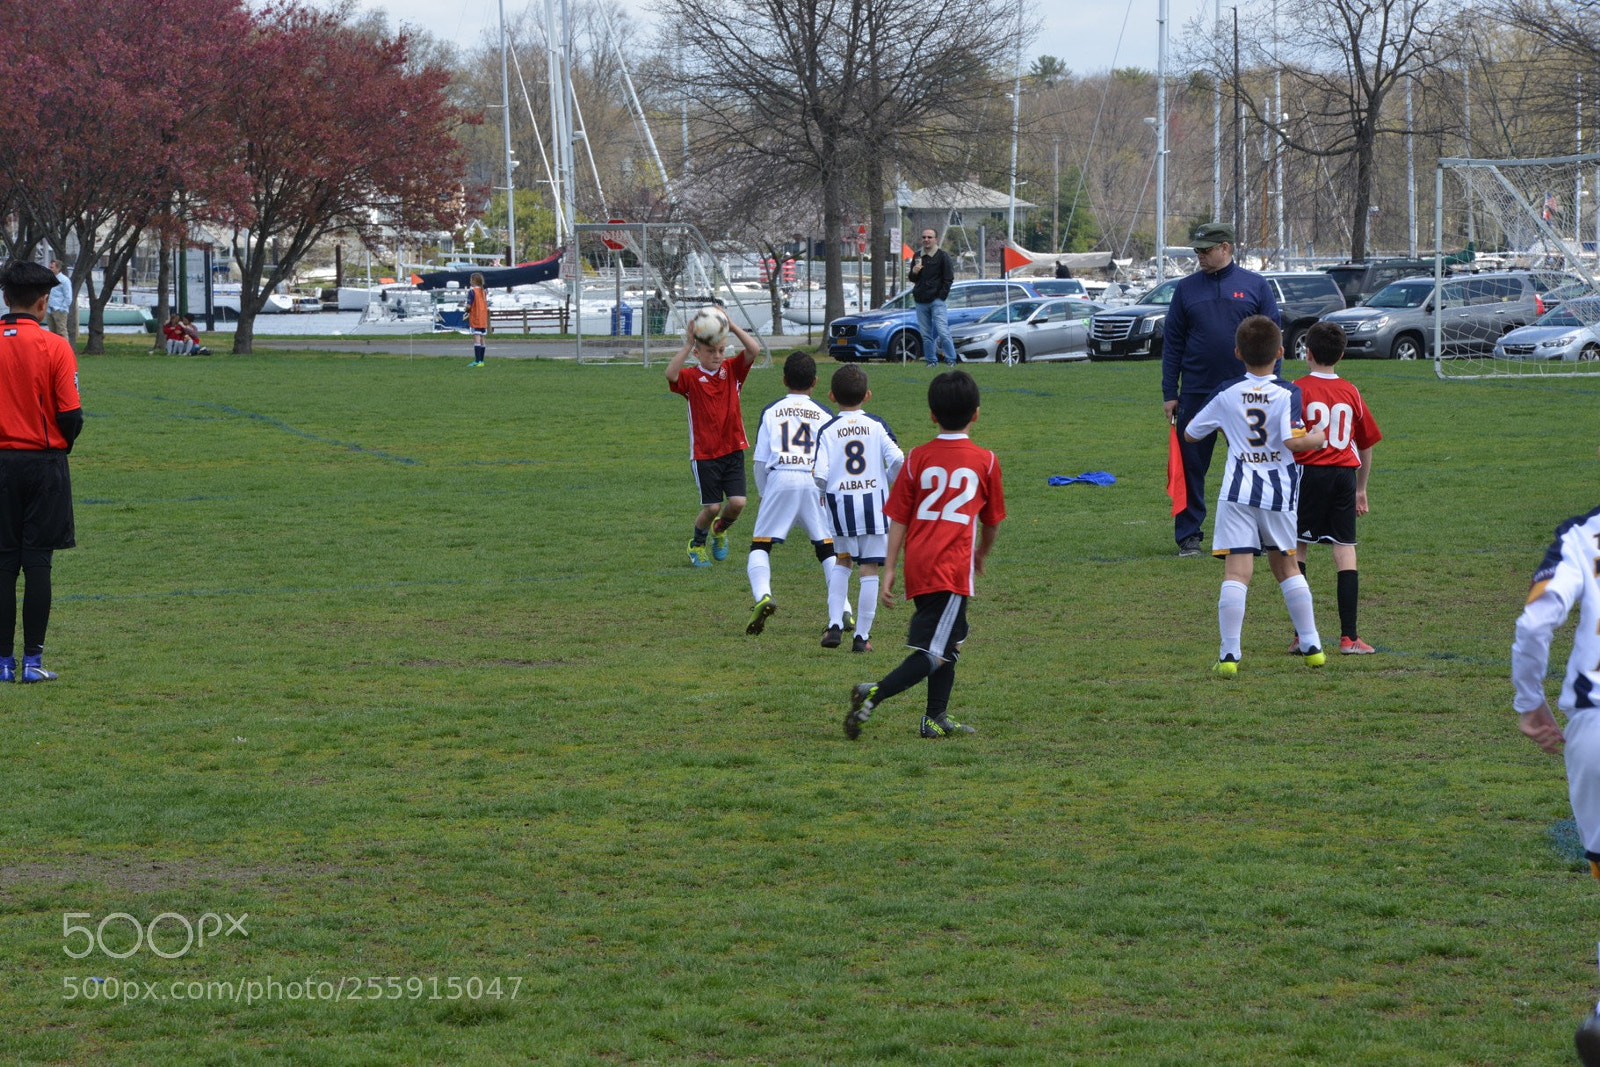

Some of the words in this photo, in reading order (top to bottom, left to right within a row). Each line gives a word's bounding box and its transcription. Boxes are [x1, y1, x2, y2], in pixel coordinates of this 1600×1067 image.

[1242, 393, 1269, 405] TOMA
[775, 407, 820, 420] LAVEYSSIERES
[1307, 401, 1353, 449] 20
[779, 420, 814, 454] 14
[1246, 408, 1267, 447] 3
[778, 455, 805, 465] ALBA
[844, 440, 867, 475] 8
[1240, 452, 1267, 463] ALBA
[1271, 451, 1282, 462] FC
[838, 480, 863, 491] ALBA
[865, 479, 877, 489] FC
[917, 466, 979, 525] 22
